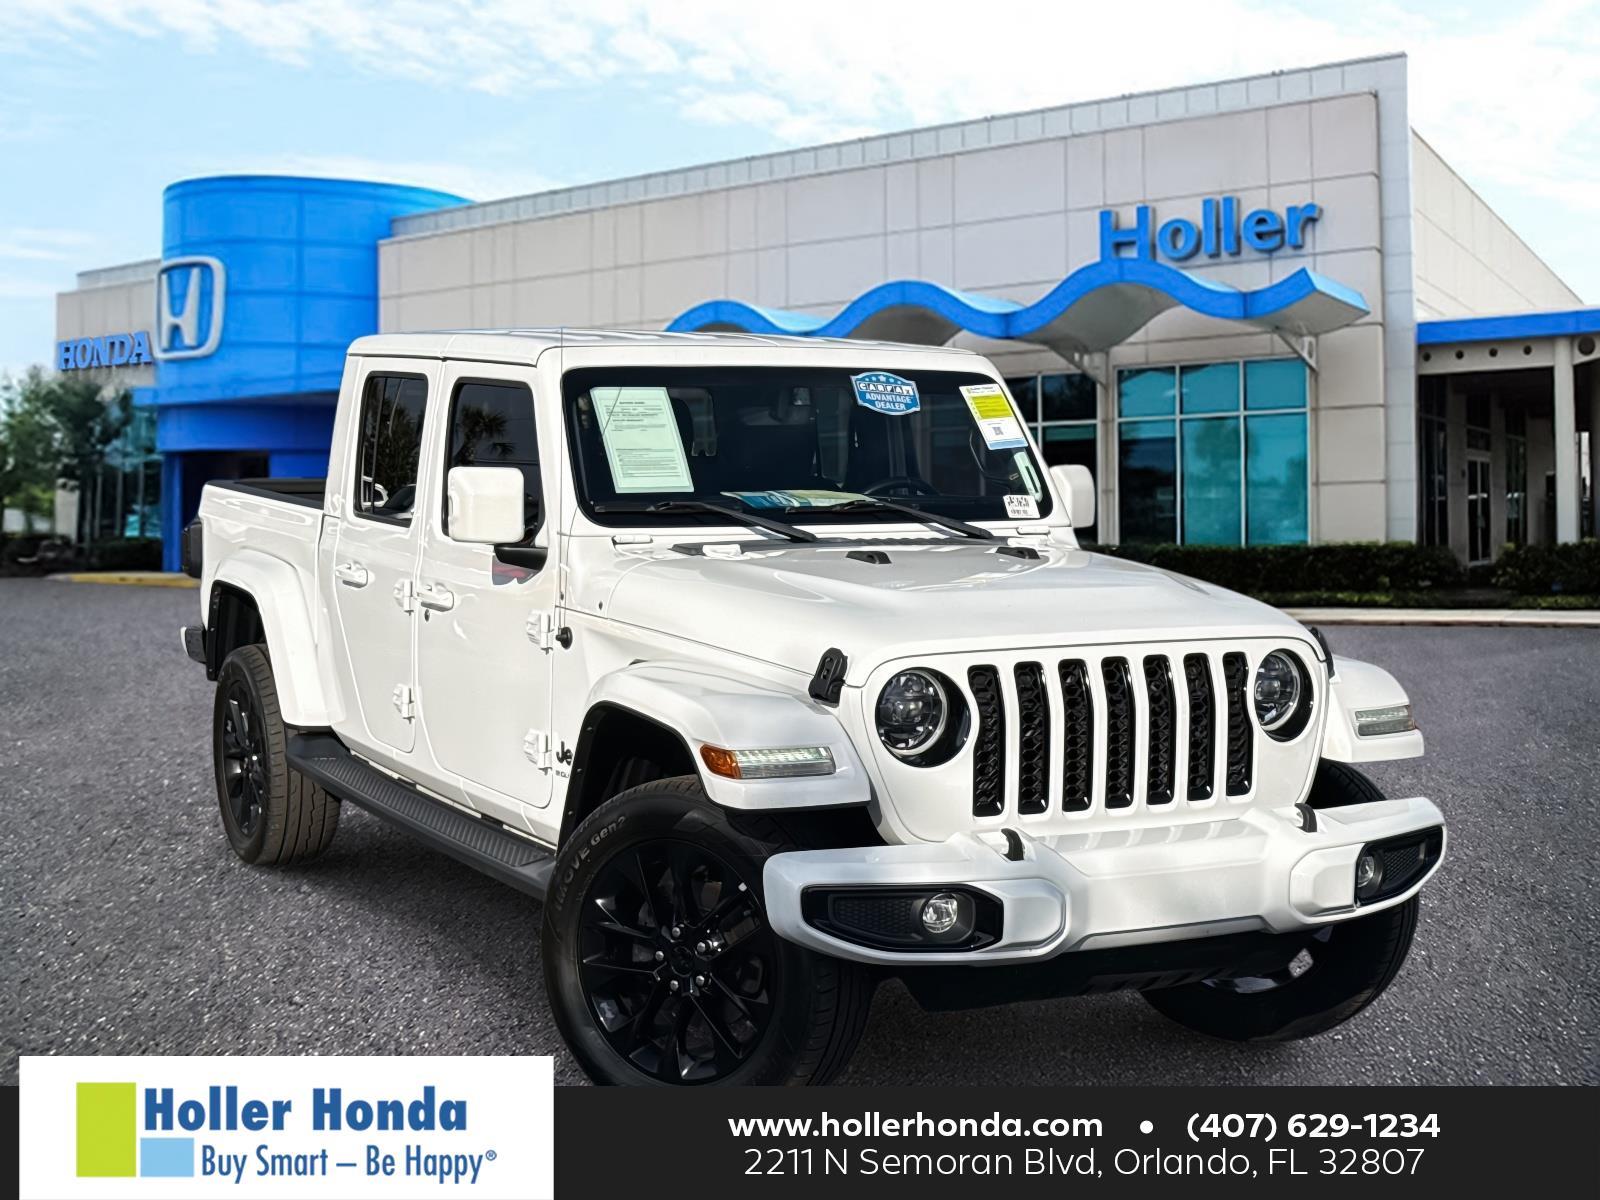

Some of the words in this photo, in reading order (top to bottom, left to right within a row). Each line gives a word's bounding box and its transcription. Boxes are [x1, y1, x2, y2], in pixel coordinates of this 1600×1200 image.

[1098, 195, 1323, 261] Holler
[57, 330, 152, 371] HONDA
[858, 381, 914, 396] CARFAX
[865, 391, 913, 404] ADVANTAGE
[874, 400, 906, 411] DEALER
